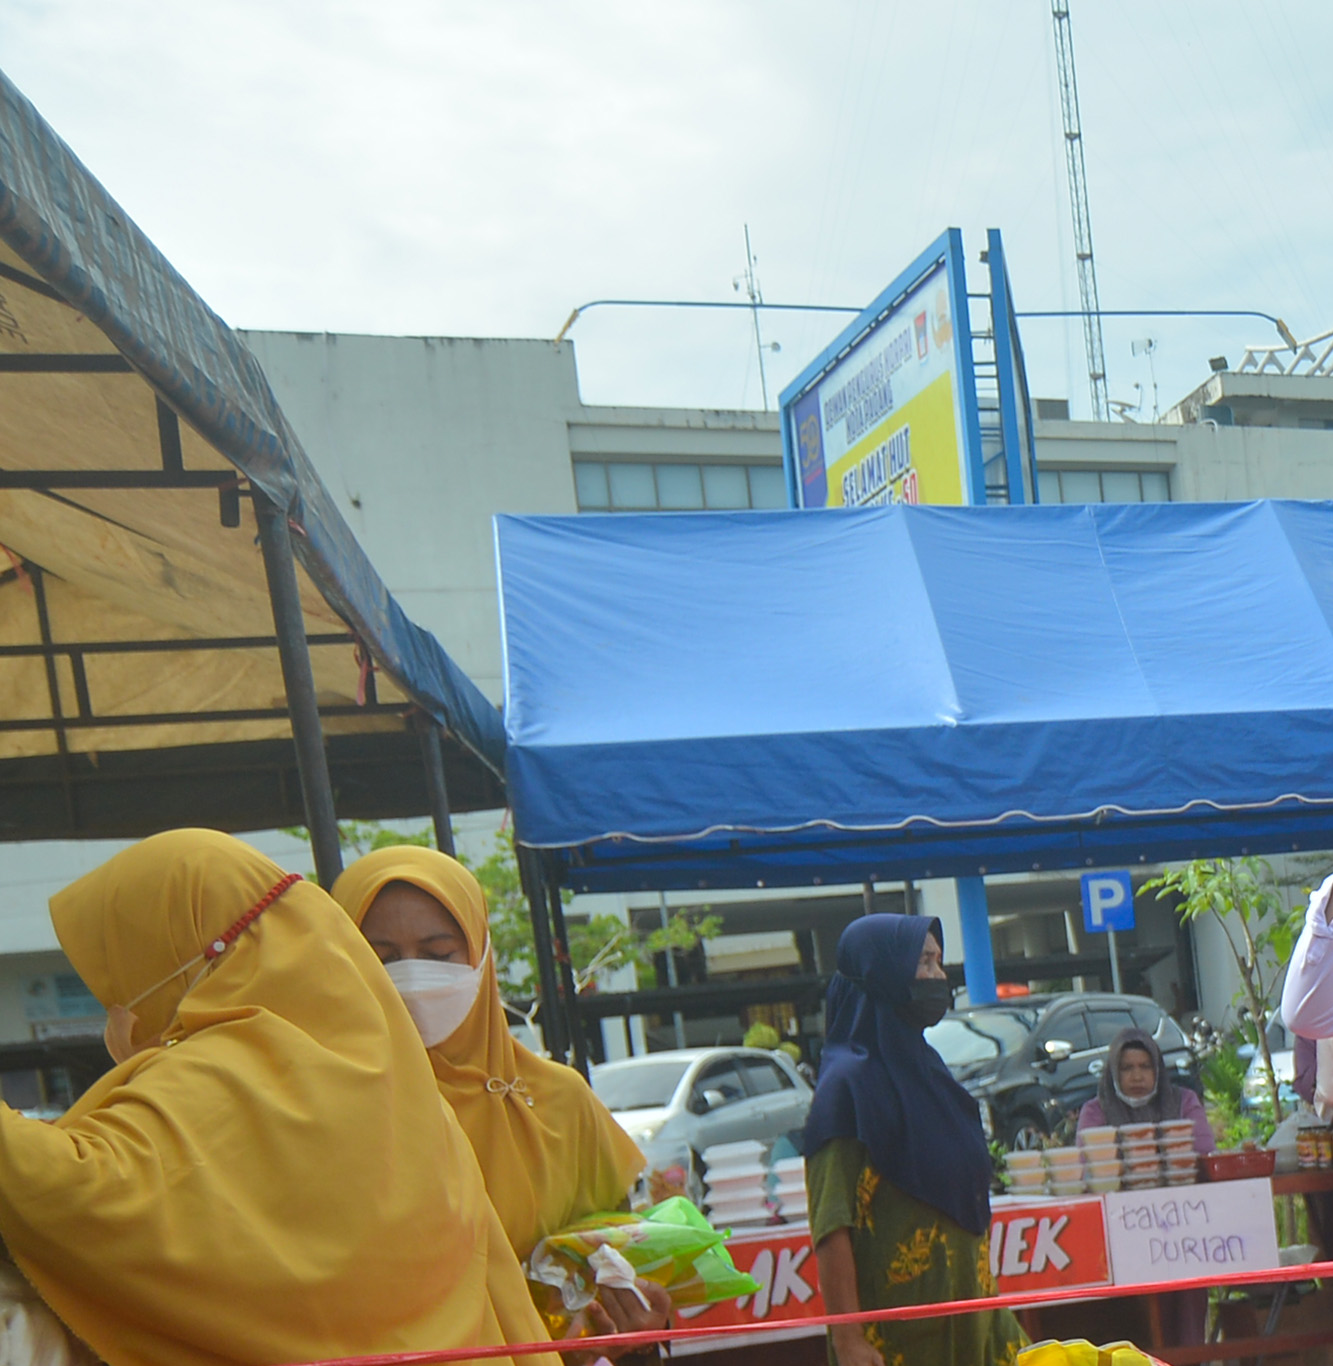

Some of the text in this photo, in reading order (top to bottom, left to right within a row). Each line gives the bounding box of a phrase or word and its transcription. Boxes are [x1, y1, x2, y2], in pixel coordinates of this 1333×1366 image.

[842, 422, 910, 508] SELAMAT HUT
[1090, 878, 1126, 920] P
[735, 1245, 815, 1320] AK
